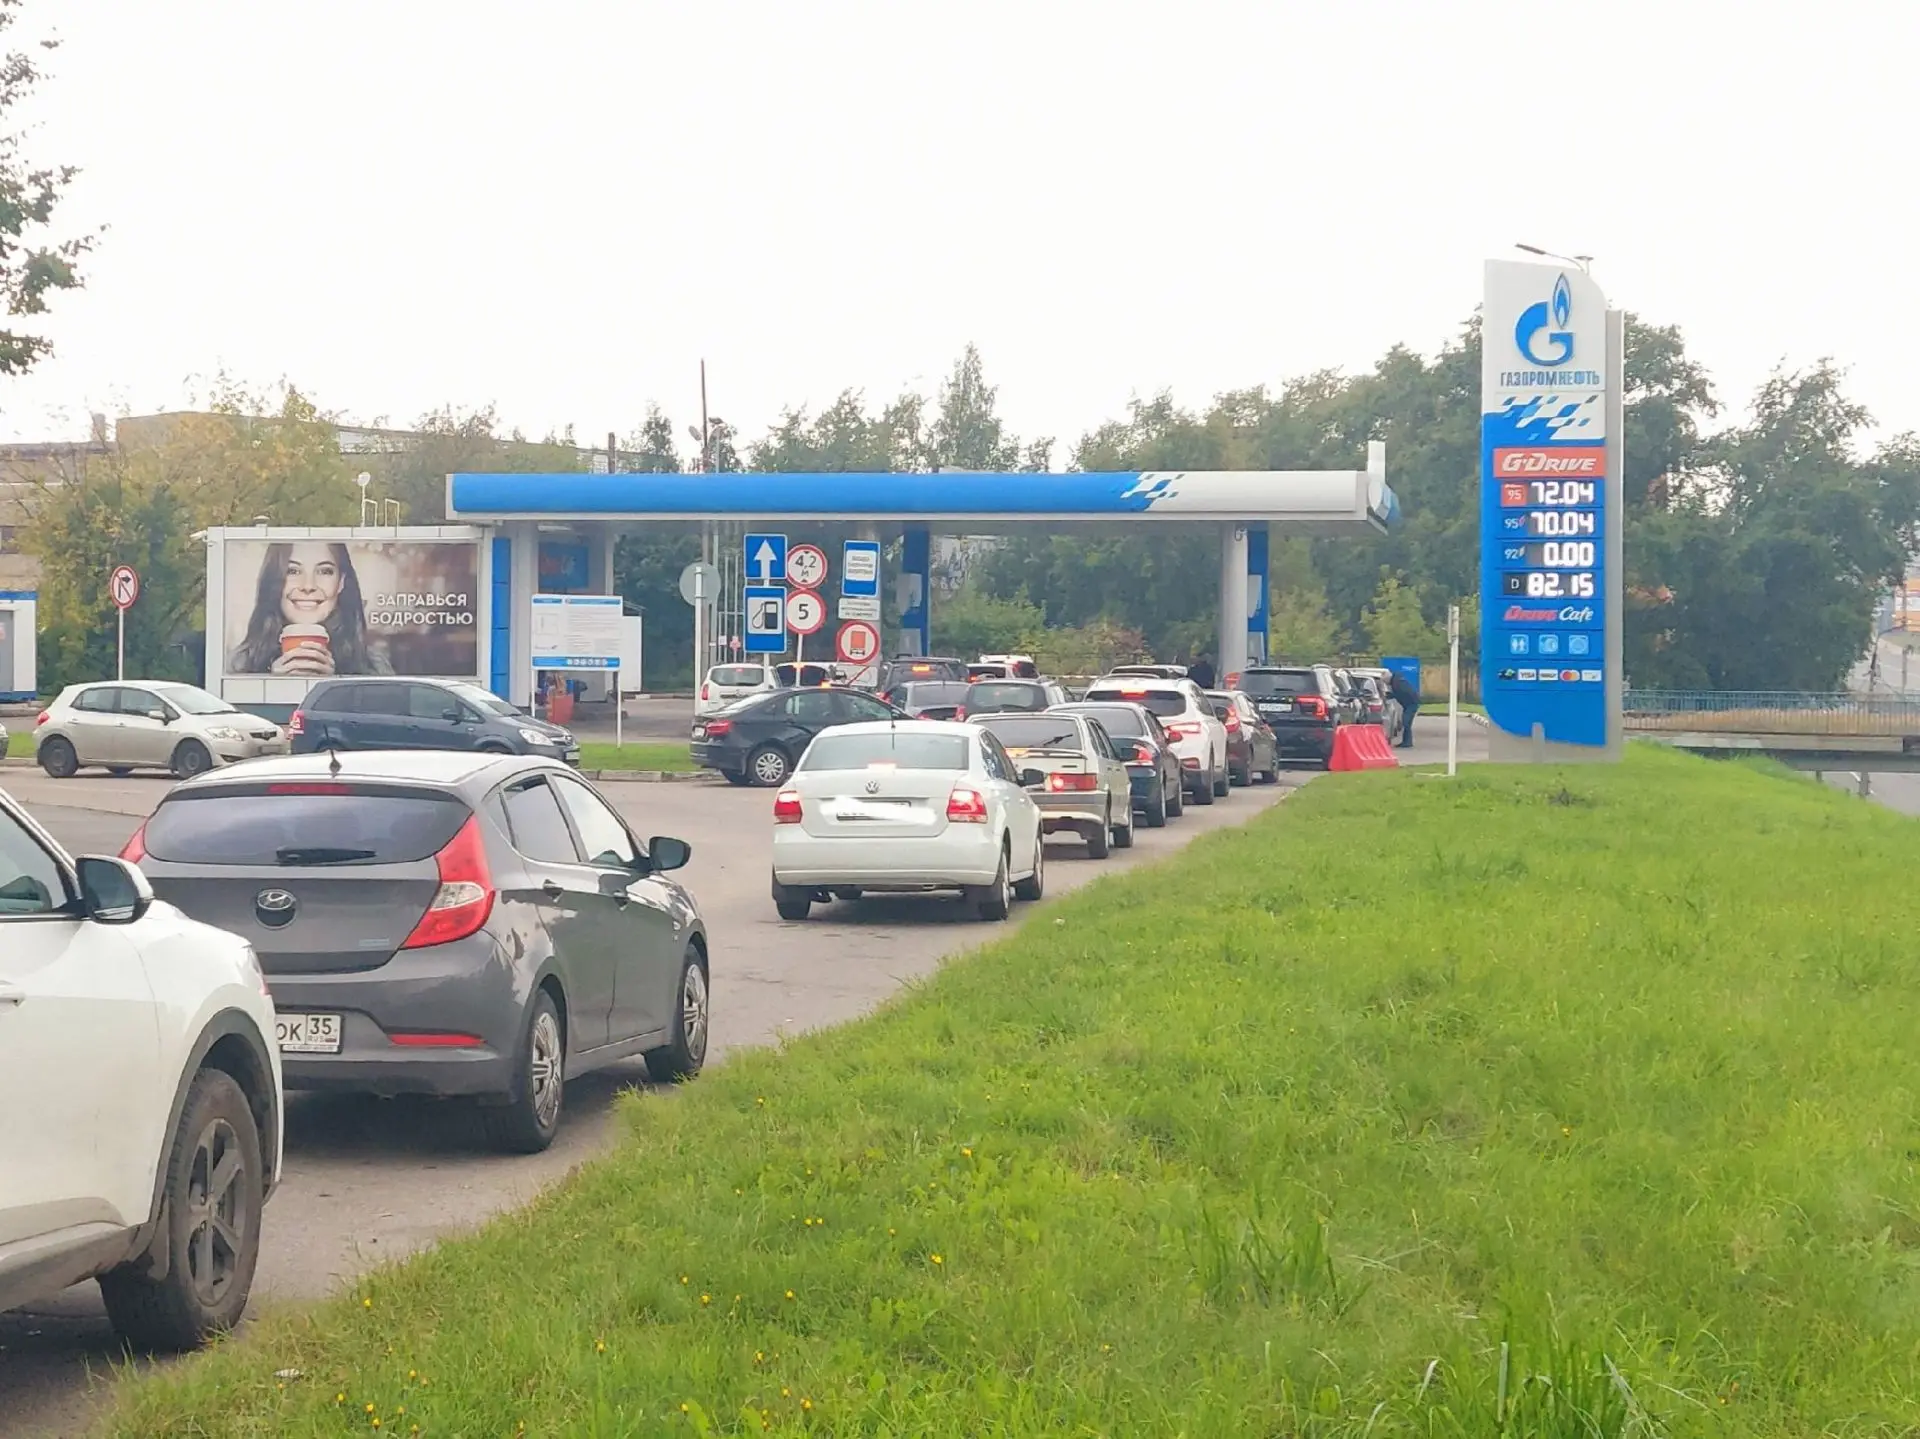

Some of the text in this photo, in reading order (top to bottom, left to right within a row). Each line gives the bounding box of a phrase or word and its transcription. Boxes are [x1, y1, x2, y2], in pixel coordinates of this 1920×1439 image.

[1500, 371, 1600, 387] ГАЗПРОМНЕФТЬ
[1508, 481, 1594, 505] 95 72.04
[1504, 511, 1594, 535] 95 70.04
[795, 555, 817, 568] 4,2
[1504, 542, 1594, 567] 92 0.00
[1511, 572, 1594, 597] D 82.15
[377, 593, 467, 606] ЗАПРАВЬСЯ
[370, 611, 473, 627] БОДРОСТЬЮ
[799, 604, 809, 619] 5
[310, 1017, 332, 1035] 35
